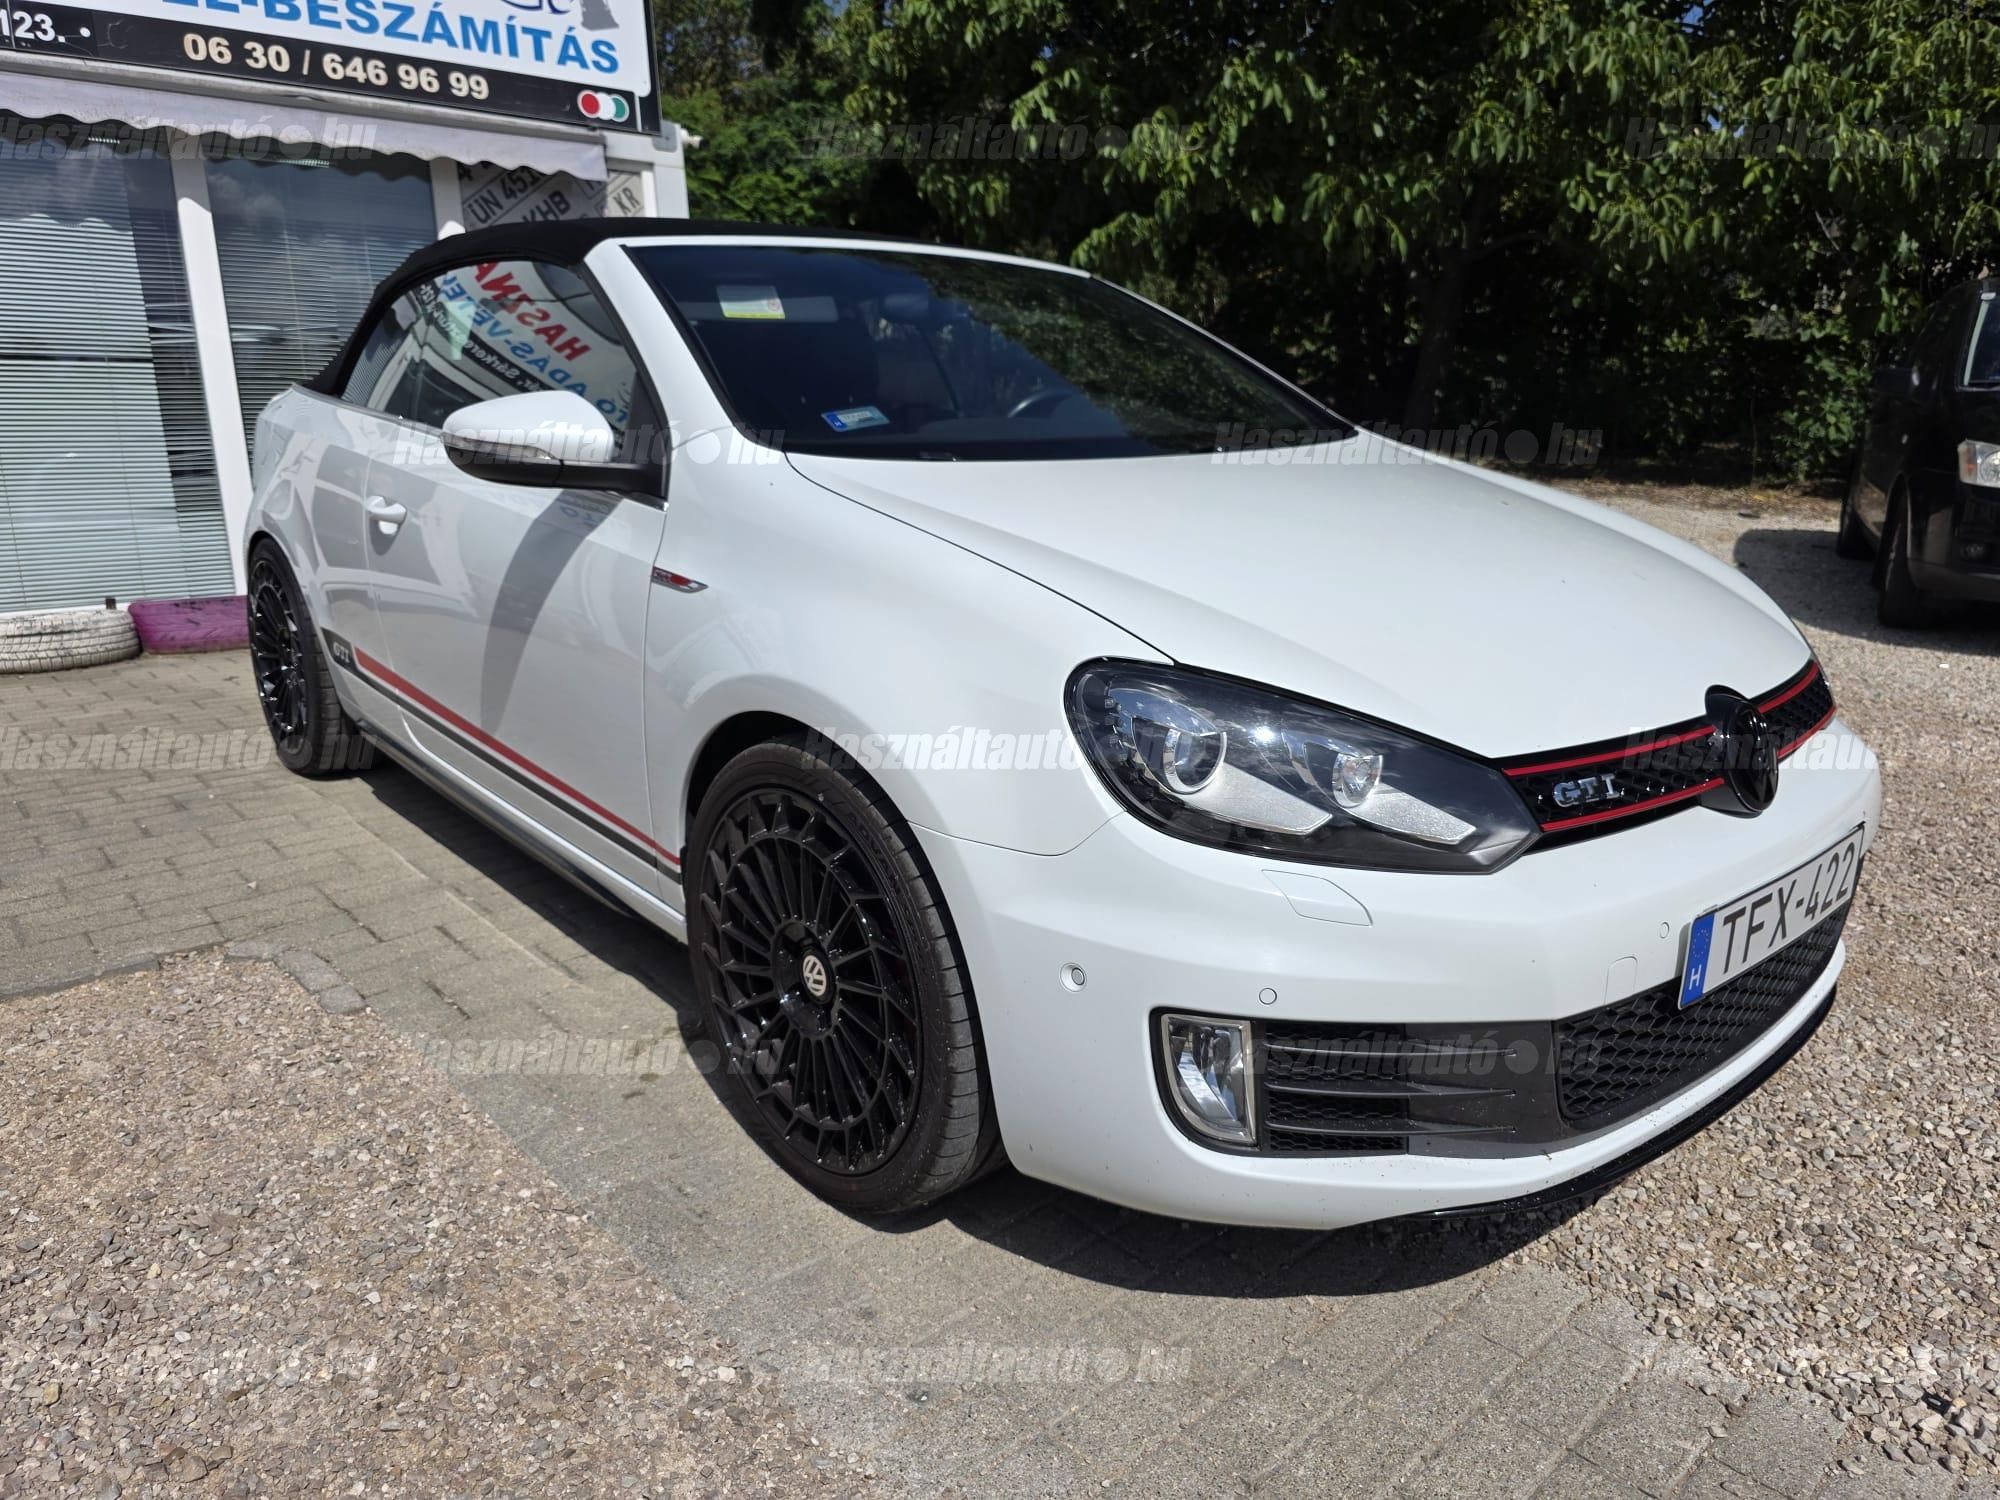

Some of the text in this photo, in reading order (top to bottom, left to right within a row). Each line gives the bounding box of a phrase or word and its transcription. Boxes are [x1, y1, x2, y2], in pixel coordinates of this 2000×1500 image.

[183, 33, 232, 65] 06
[243, 41, 291, 73] 30
[302, 49, 311, 76] /
[322, 52, 389, 87] 646
[397, 63, 440, 94] 96
[448, 71, 490, 100] 99
[613, 187, 641, 216] KR
[1553, 773, 1621, 808] GTI
[1689, 842, 1855, 990] H TFX-422
